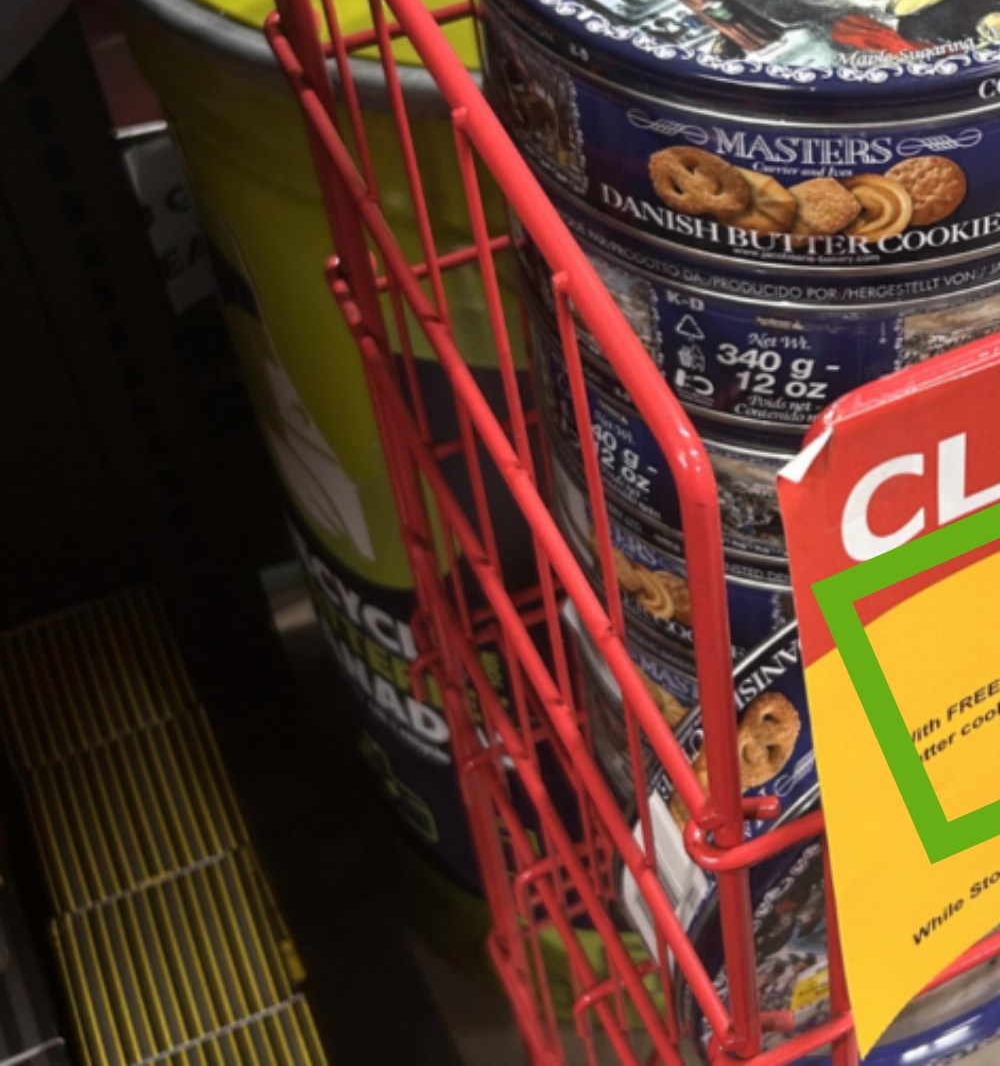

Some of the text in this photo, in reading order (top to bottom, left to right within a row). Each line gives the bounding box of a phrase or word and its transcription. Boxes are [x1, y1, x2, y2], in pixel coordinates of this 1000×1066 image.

[713, 126, 893, 165] MASTERS
[751, 160, 799, 176] Currier
[800, 165, 827, 177] and
[600, 182, 721, 243] DANISH
[726, 225, 872, 256] BUTTER
[748, 332, 778, 349] Net
[716, 342, 782, 372] 340
[790, 357, 815, 381] g
[735, 370, 829, 399] 12 oz
[620, 465, 652, 494] oz
[946, 677, 1000, 723] FREE
[920, 732, 957, 763] tter
[912, 897, 965, 946] While
